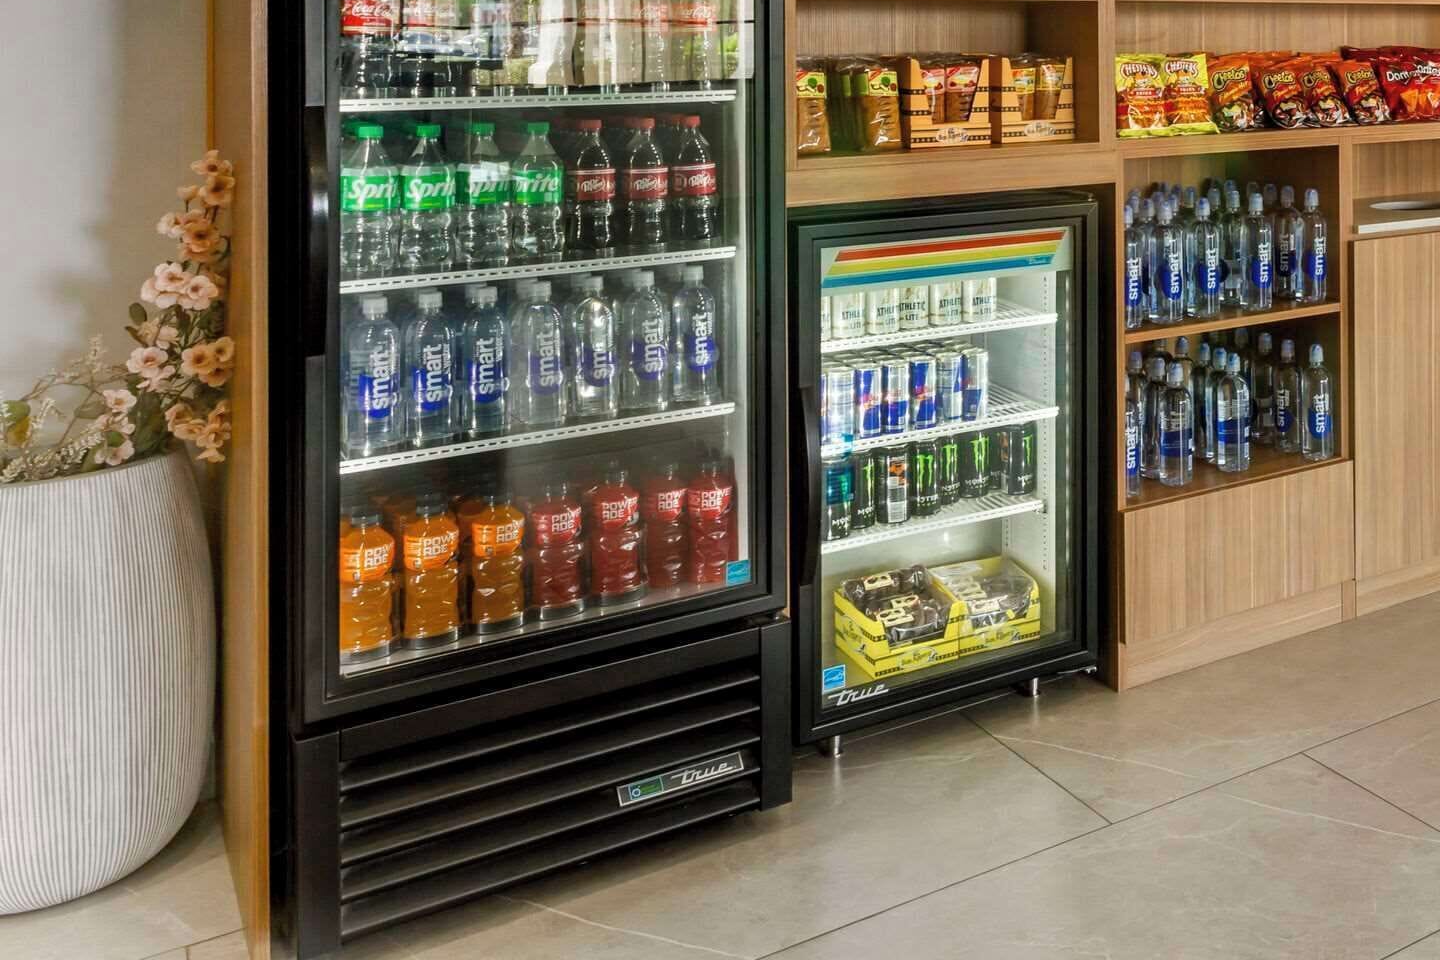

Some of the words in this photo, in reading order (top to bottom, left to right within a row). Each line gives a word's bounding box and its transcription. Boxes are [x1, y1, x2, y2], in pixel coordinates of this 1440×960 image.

[1211, 68, 1247, 91] Cheetos
[1263, 70, 1296, 90] Cheetos
[1168, 252, 1181, 295] smart
[1206, 248, 1217, 289] smart
[1258, 242, 1269, 284] smart
[1314, 236, 1324, 276] smart
[1125, 256, 1139, 301] smart
[536, 329, 556, 387] smart
[642, 319, 659, 374] smart
[692, 312, 709, 367] smart
[370, 344, 390, 410] smart
[423, 343, 444, 404] smart
[475, 337, 496, 396] smart
[1314, 393, 1326, 433] smart
[1124, 426, 1137, 470] smart
